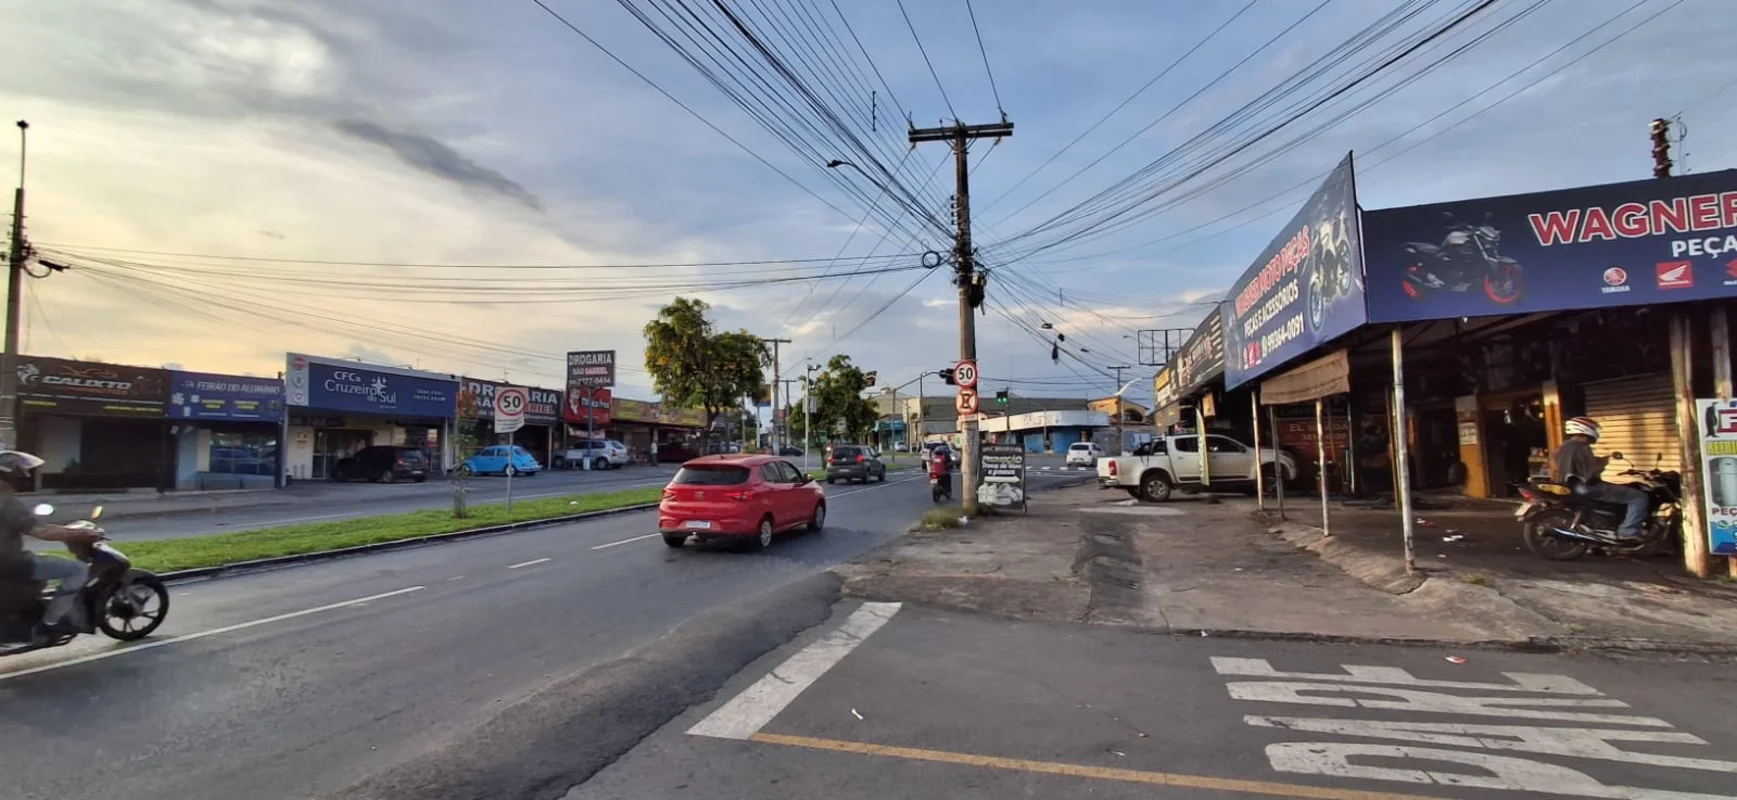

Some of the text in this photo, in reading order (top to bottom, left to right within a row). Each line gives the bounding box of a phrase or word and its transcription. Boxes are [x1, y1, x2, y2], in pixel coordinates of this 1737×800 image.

[1280, 225, 1310, 276] PEÇAS
[1602, 285, 1630, 294] YAMAHA
[1261, 279, 1299, 324] ACESSÓRIOS
[568, 353, 612, 366] DROGARIA
[959, 368, 973, 380] 50
[196, 380, 280, 395] FEIRÃO DO ALUMÍNIO
[325, 379, 377, 397] Cruzeiro
[469, 382, 558, 404] DRRIA
[379, 391, 396, 404] Sul
[503, 395, 521, 408] 50
